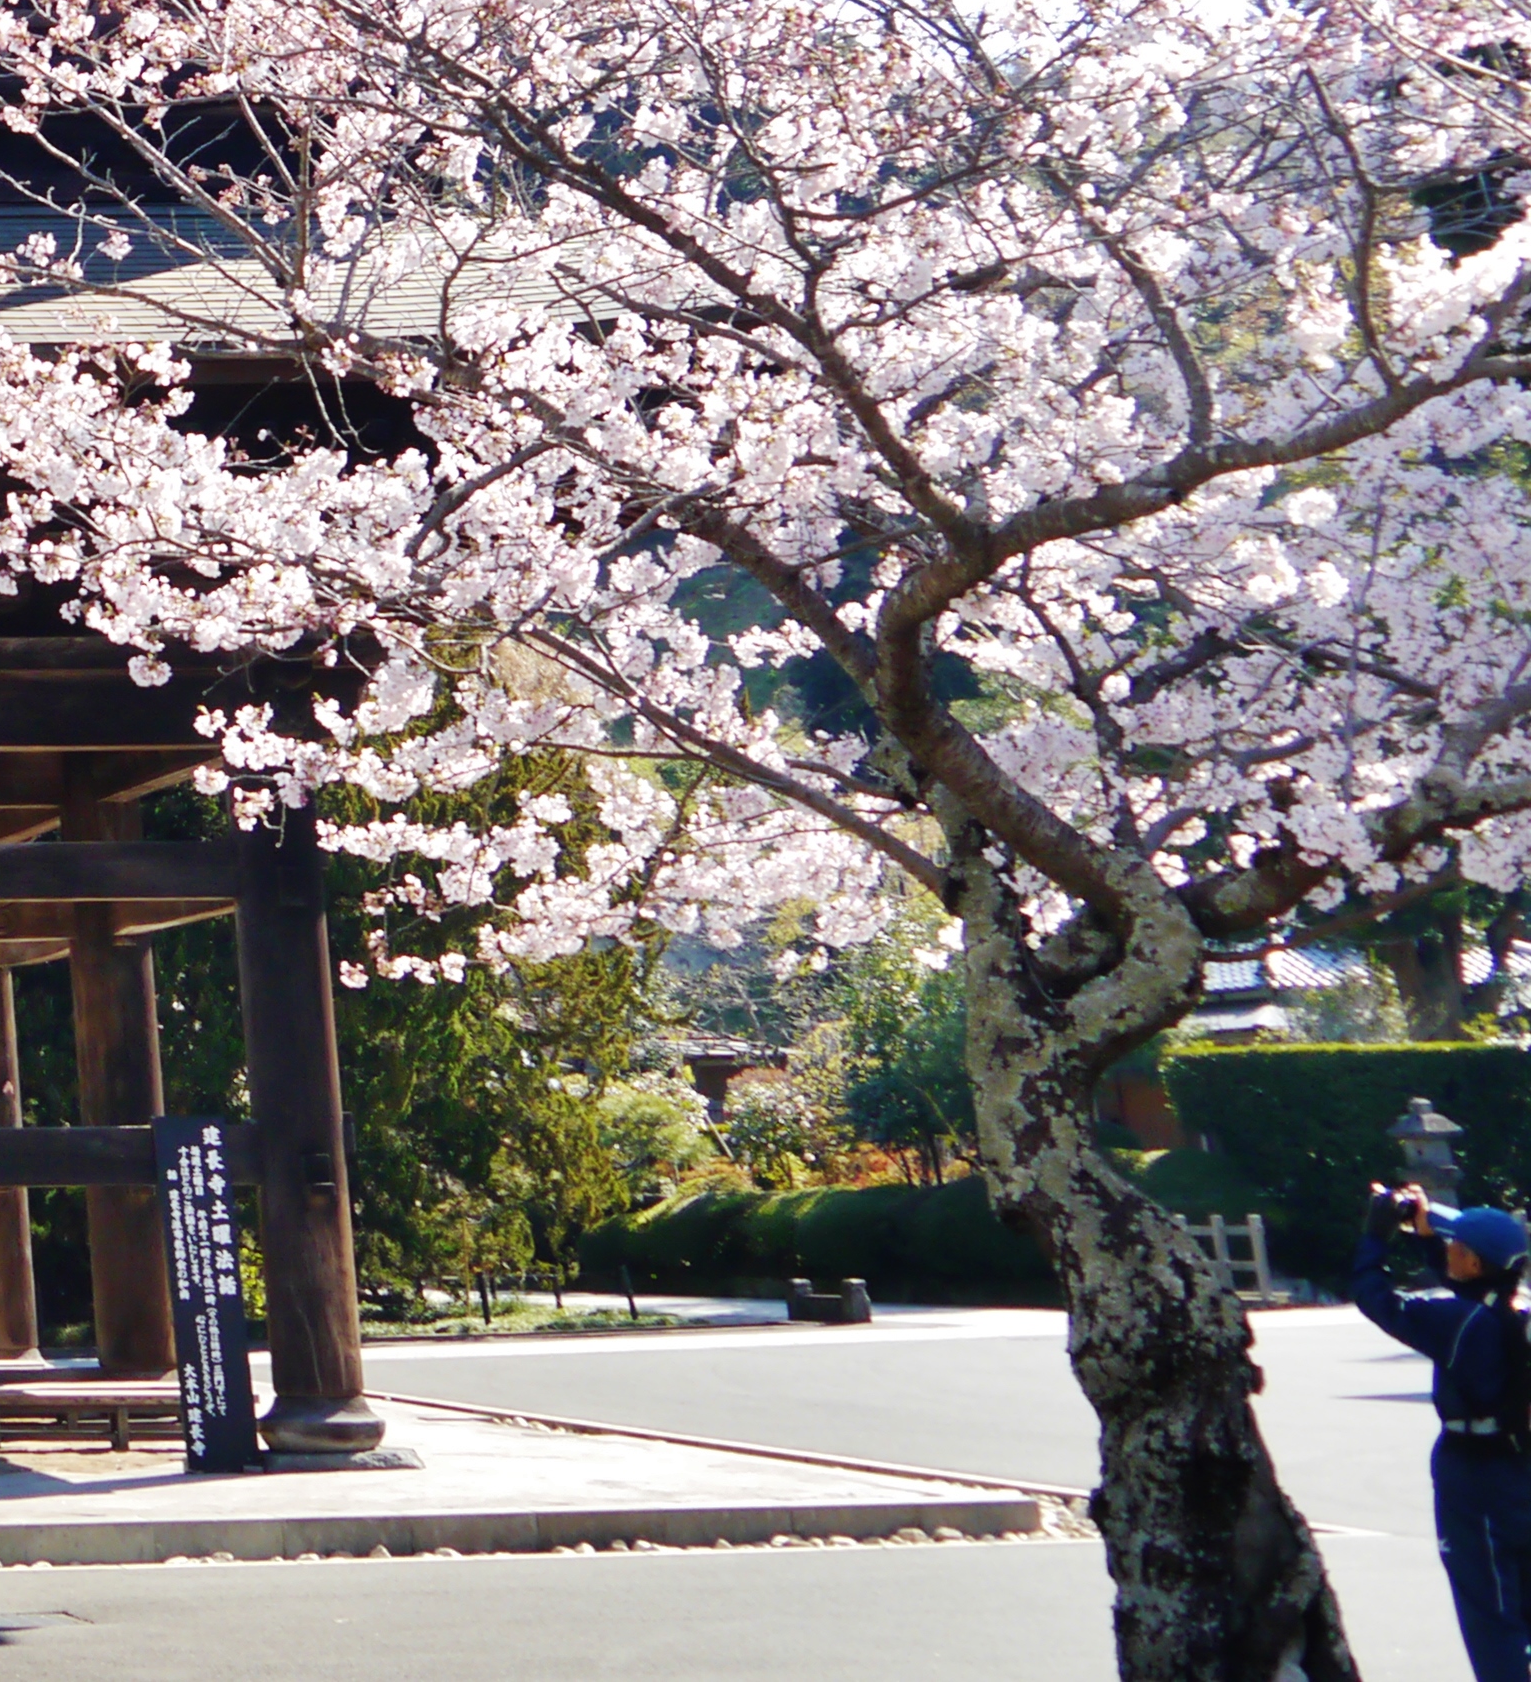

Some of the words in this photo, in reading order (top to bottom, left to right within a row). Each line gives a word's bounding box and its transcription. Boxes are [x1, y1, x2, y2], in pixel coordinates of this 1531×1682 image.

[202, 1126, 236, 1295] 建長寺土曜法話
